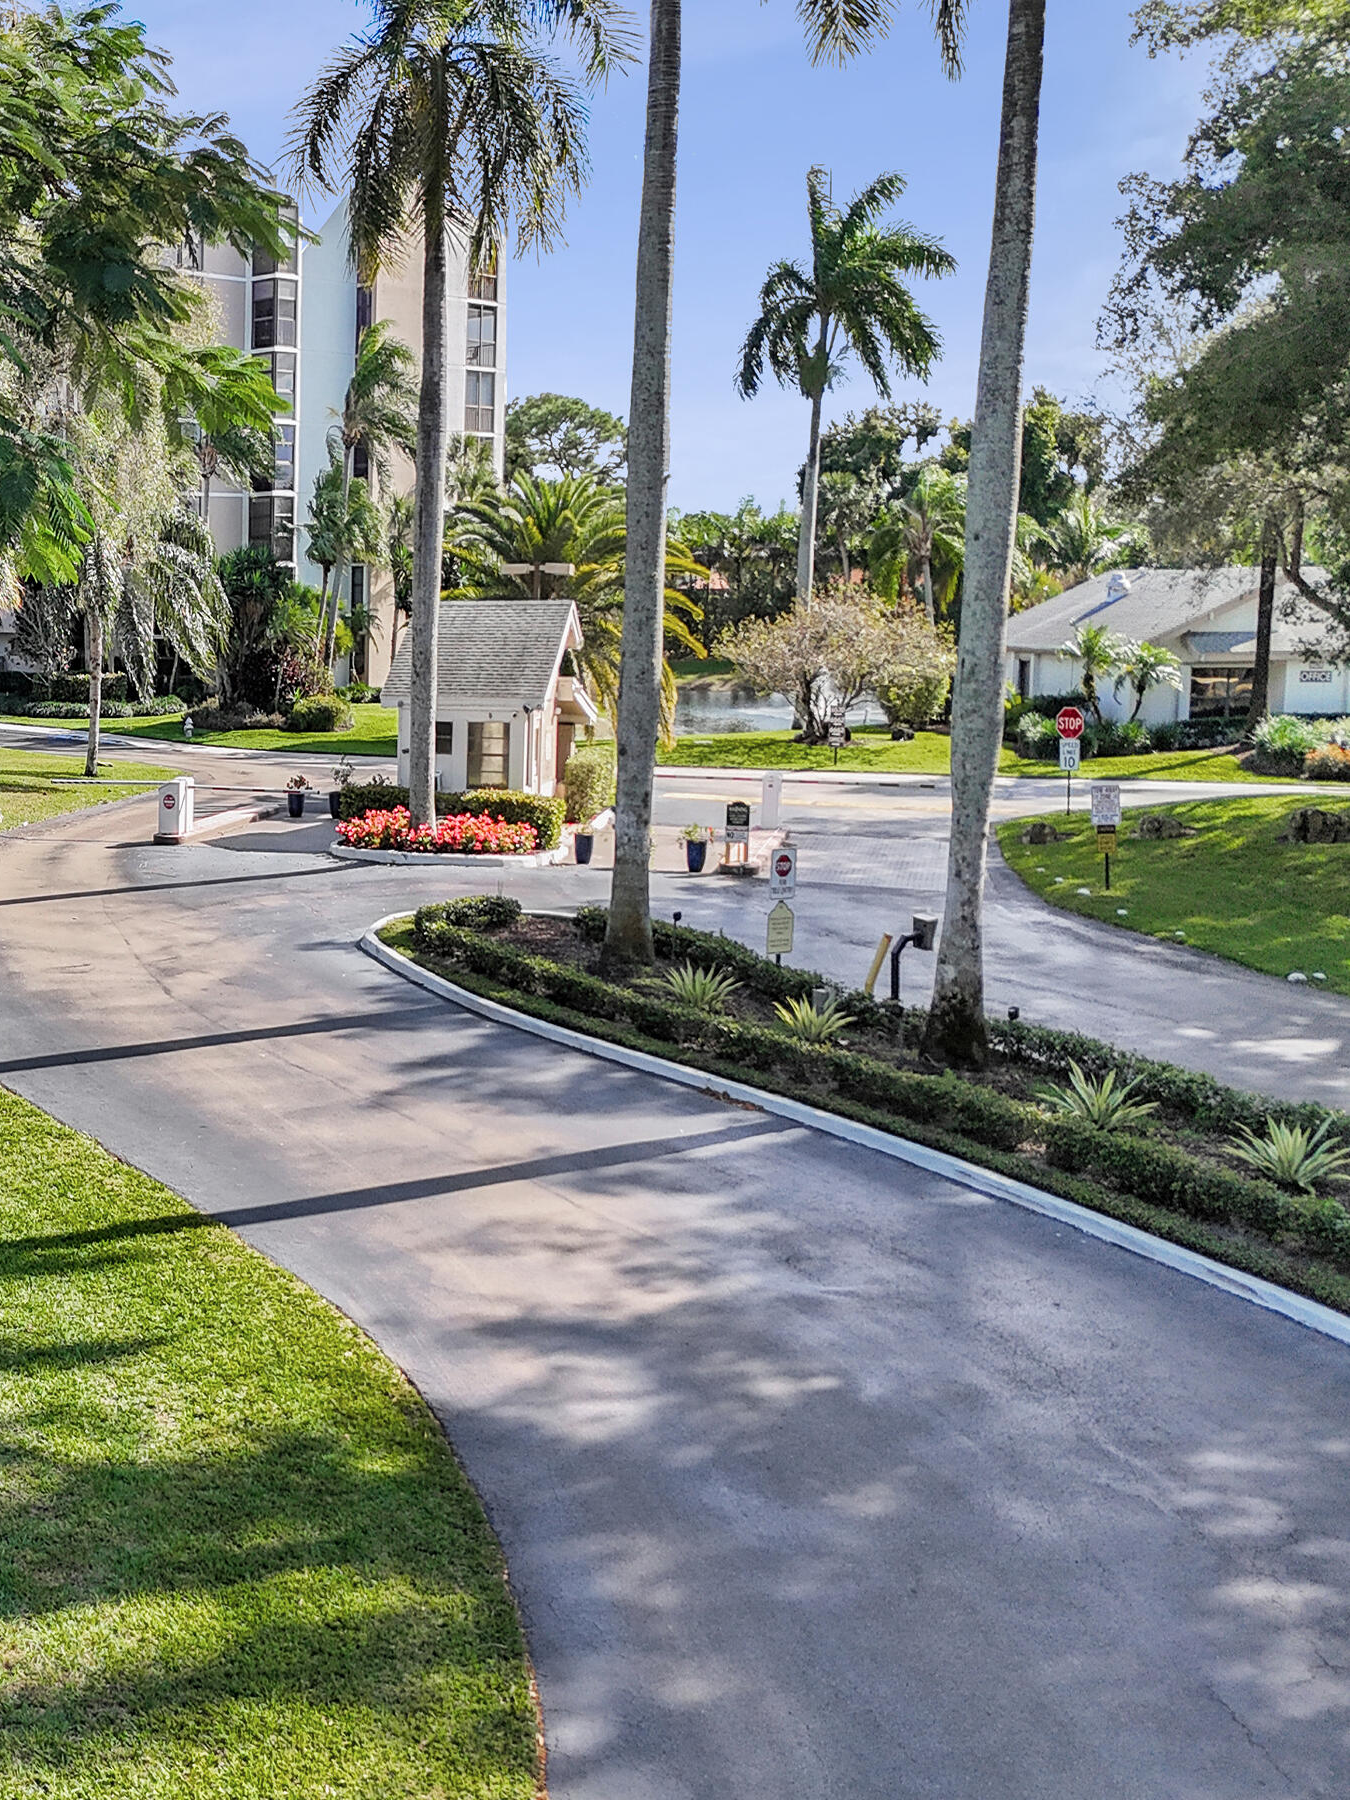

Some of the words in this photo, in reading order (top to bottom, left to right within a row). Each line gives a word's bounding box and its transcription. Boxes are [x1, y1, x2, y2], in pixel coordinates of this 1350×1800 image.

[1301, 671, 1331, 681] OFFICE
[1059, 717, 1082, 730] STOP
[1064, 756, 1075, 768] 10
[775, 861, 791, 871] STOP
